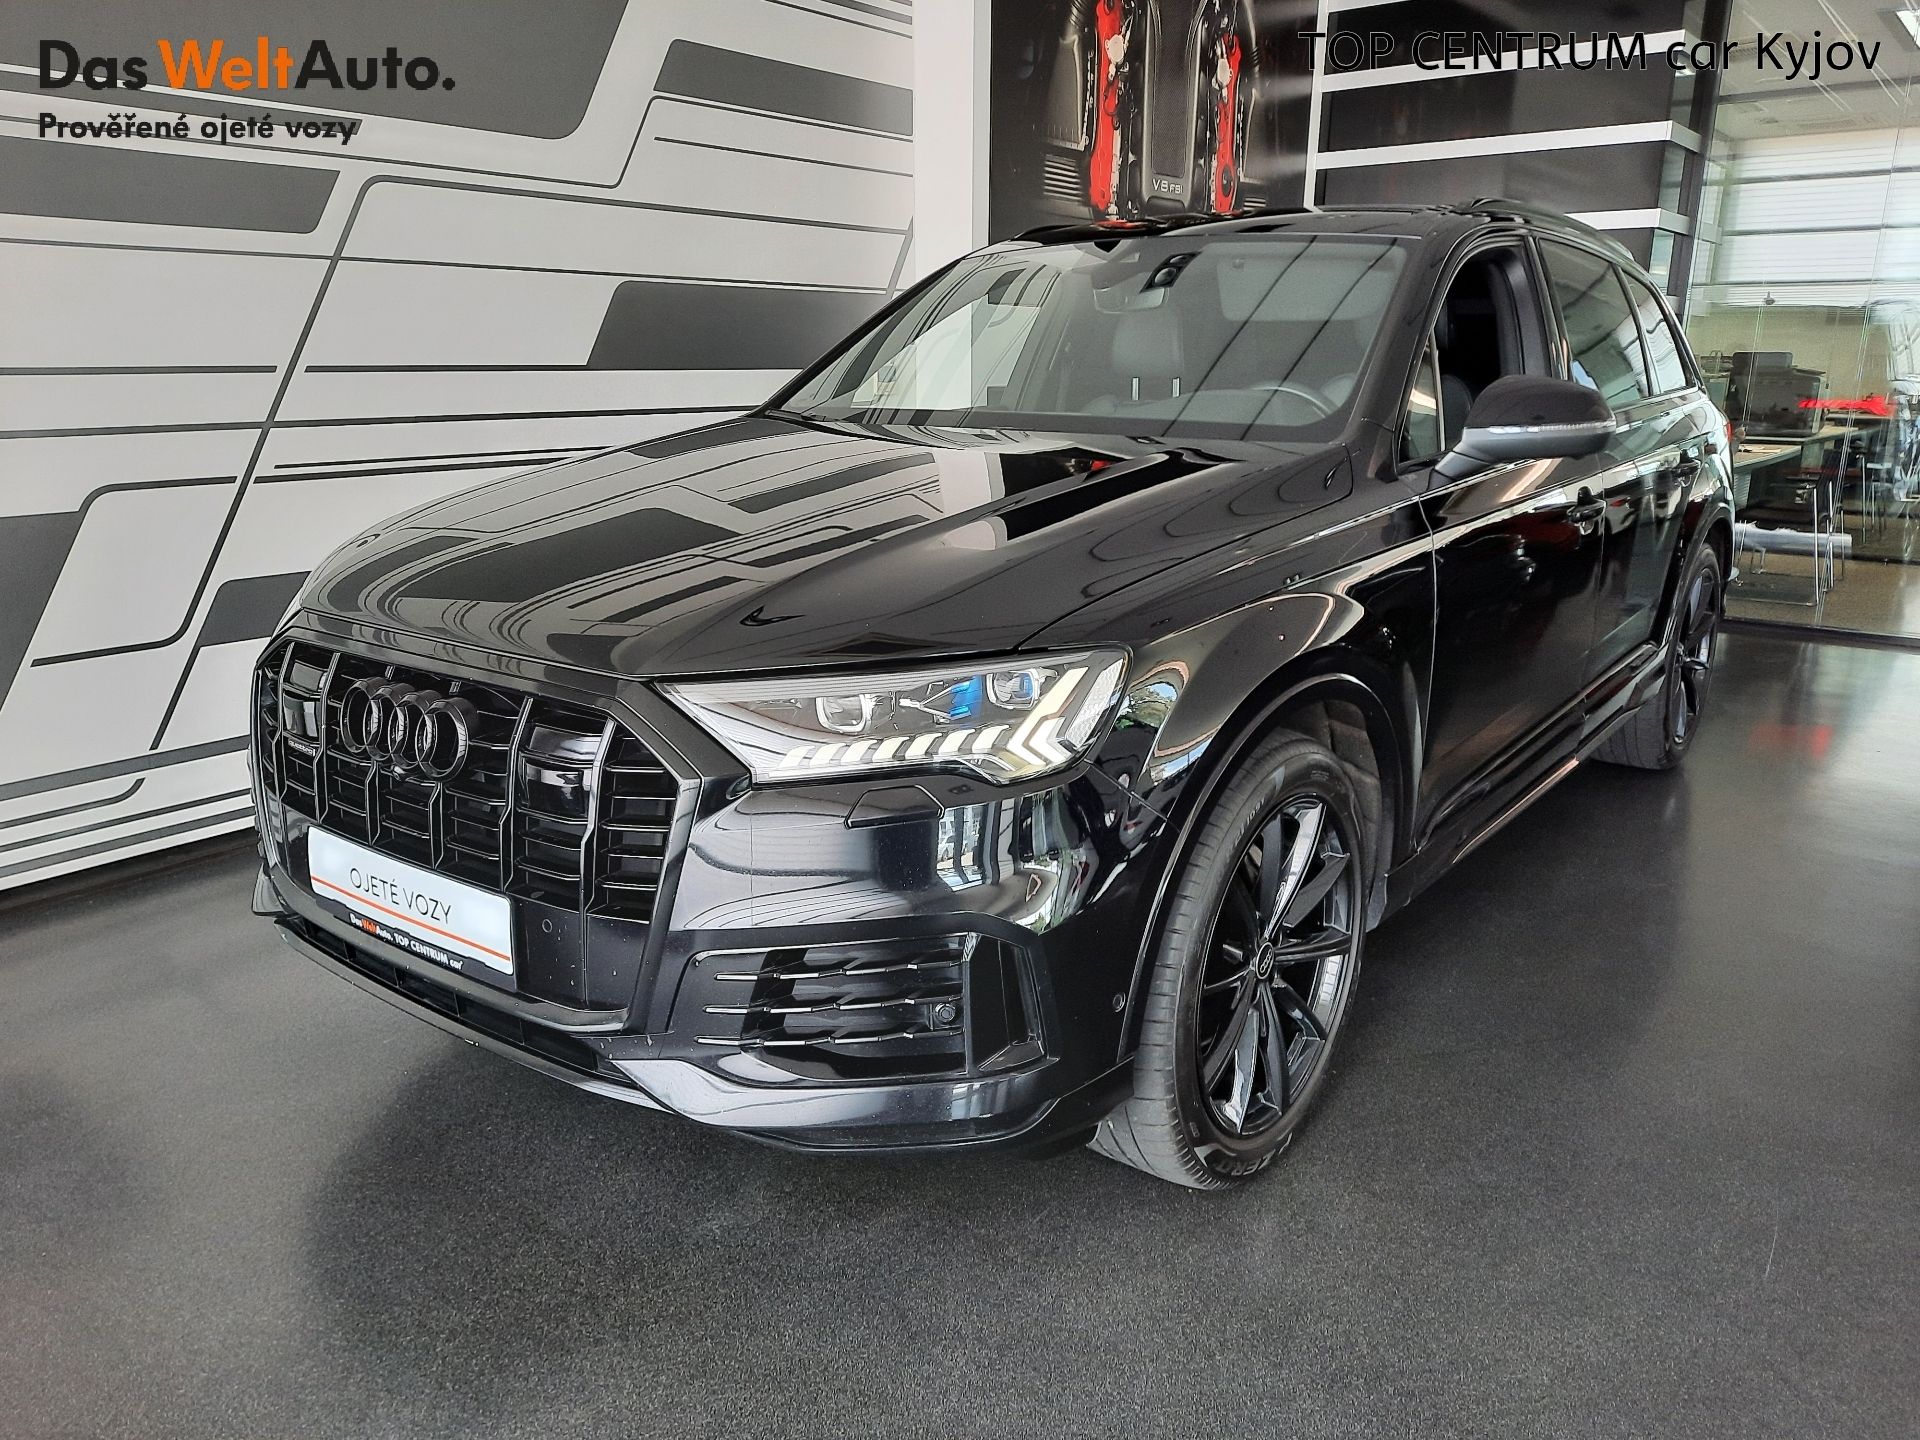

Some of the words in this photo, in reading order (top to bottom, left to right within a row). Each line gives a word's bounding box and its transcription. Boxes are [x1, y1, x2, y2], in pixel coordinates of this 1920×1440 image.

[1152, 179, 1168, 192] V8
[350, 868, 400, 905] OJETÉ
[403, 888, 451, 924] VOZY
[394, 932, 410, 947] TOP
[410, 941, 449, 965] CENTRUM
